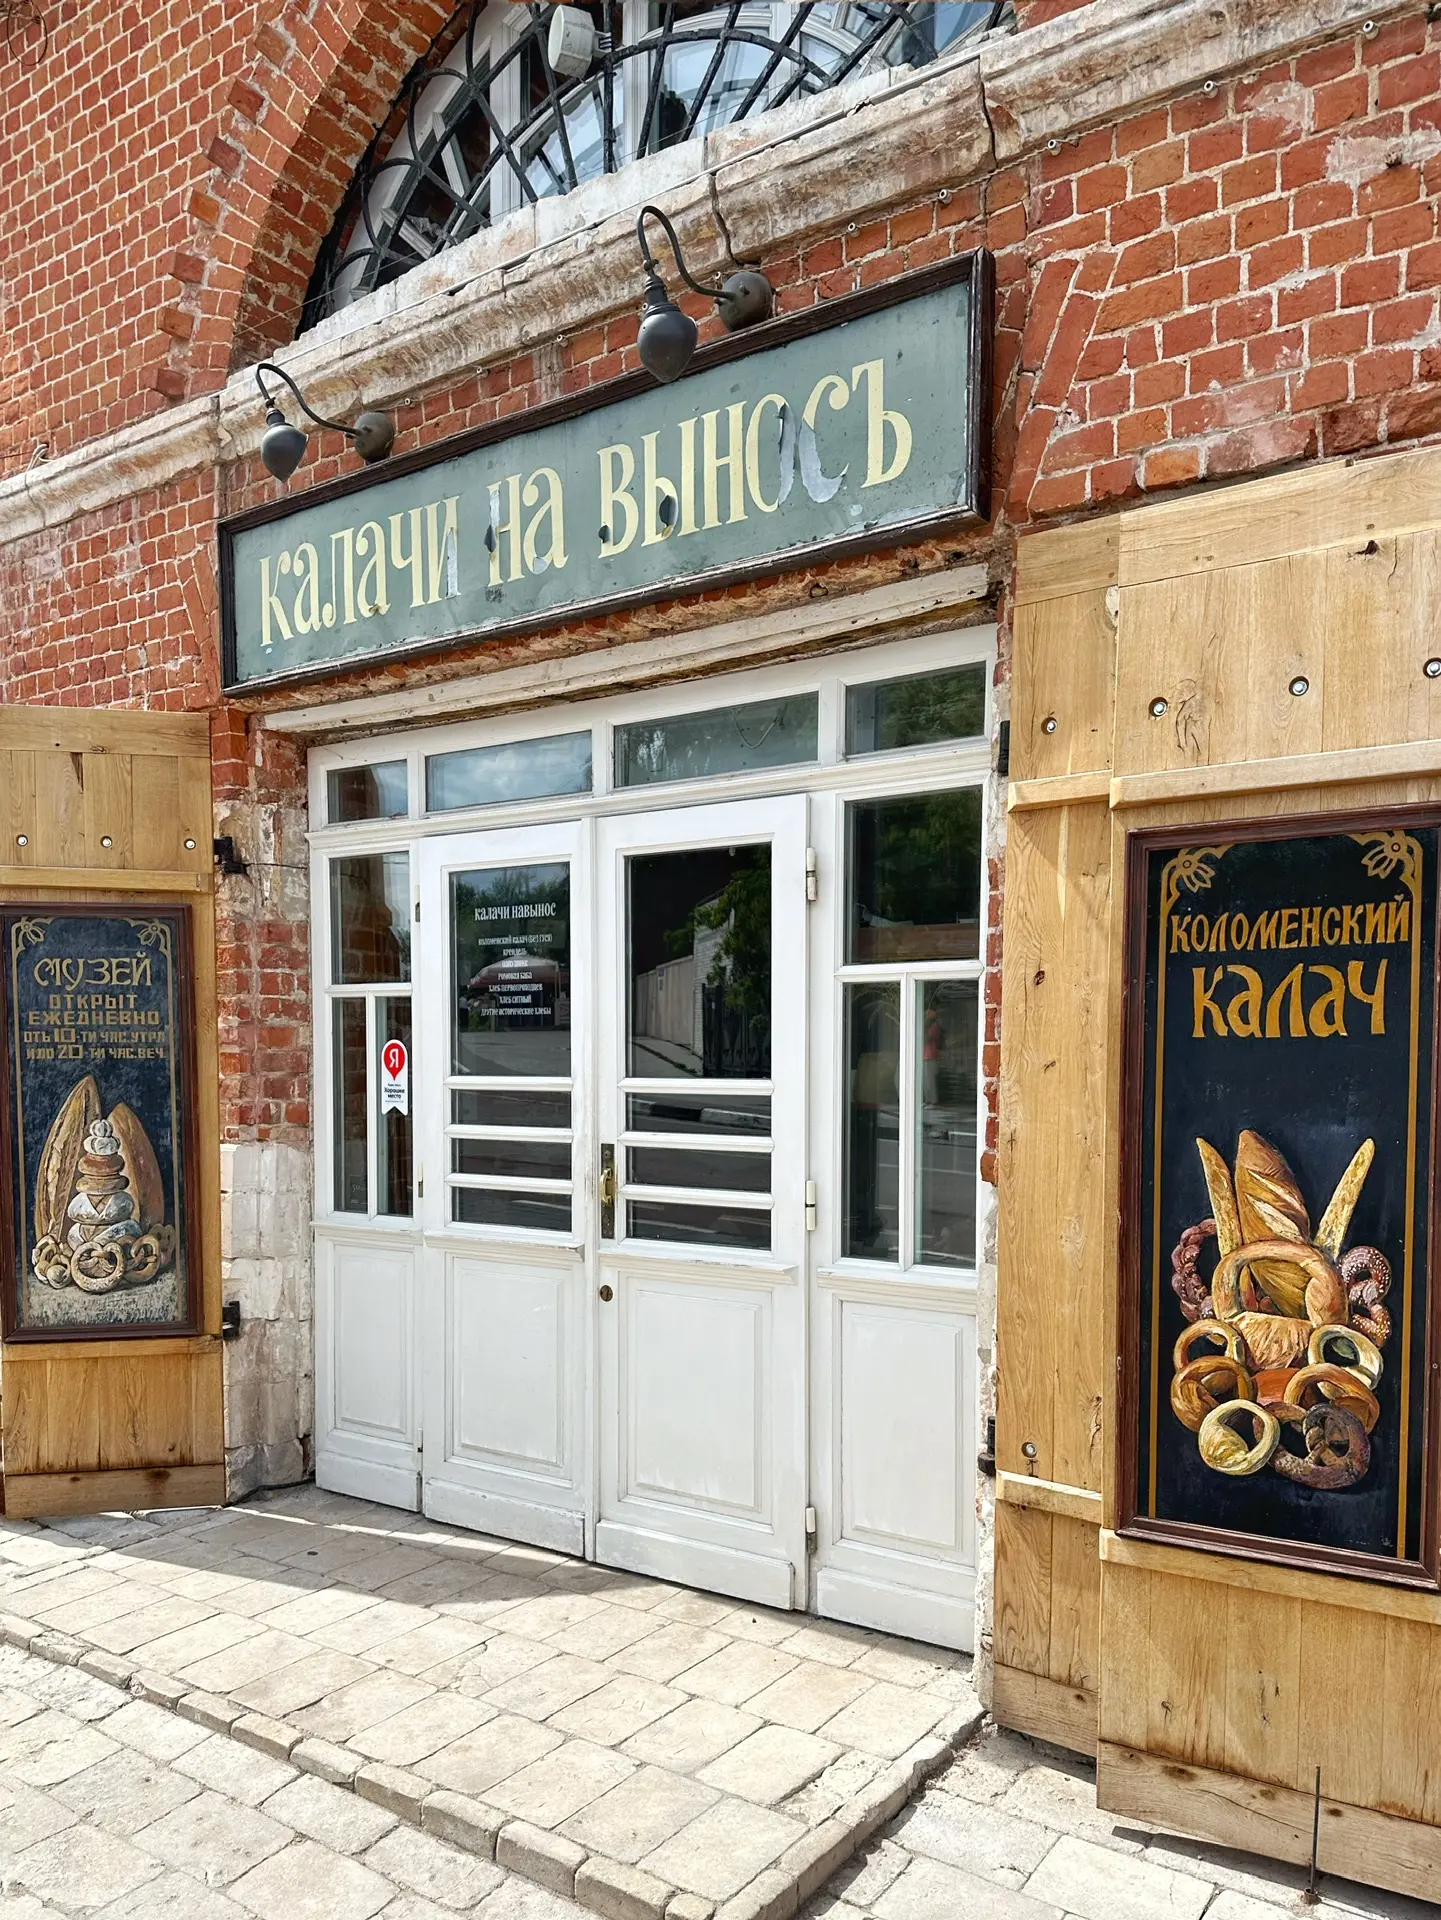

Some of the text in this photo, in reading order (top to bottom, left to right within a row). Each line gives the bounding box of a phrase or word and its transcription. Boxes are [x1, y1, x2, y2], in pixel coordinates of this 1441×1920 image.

[596, 358, 913, 559] ВЫНОСЪ
[1169, 893, 1411, 954] КОЛОМЕНСКИЙ
[33, 950, 152, 991] МУЗЕЙ
[49, 994, 139, 1010] ОТКРЫТ
[28, 1010, 160, 1026] ЕЖЕДНЕВНО
[23, 1031, 50, 1043] ОТЪ
[389, 1048, 399, 1068] Я
